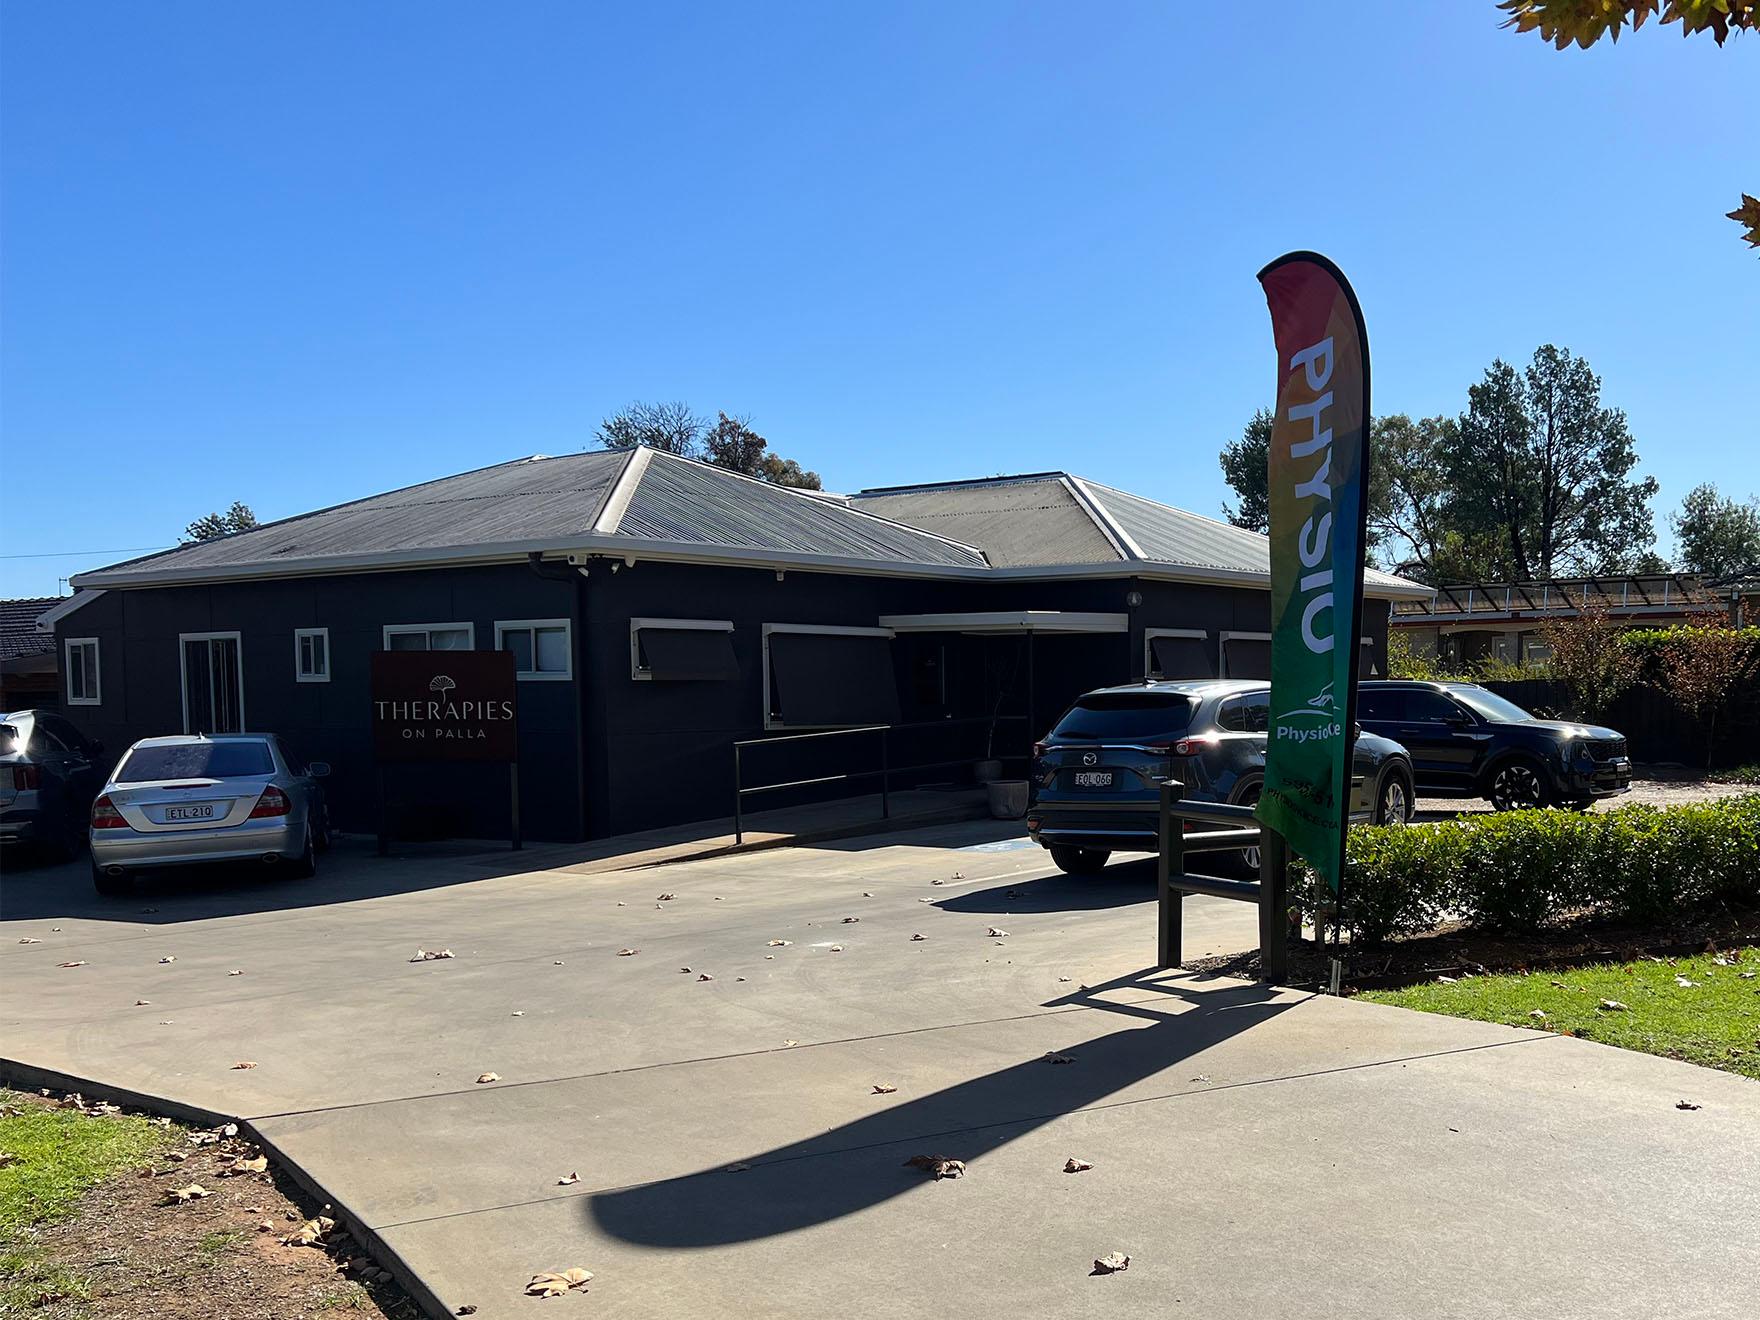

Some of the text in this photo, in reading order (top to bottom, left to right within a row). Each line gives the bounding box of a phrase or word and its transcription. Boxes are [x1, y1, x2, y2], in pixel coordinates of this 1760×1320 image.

[1288, 336, 1335, 655] PHYSIO
[375, 701, 513, 720] THERAPIES
[402, 728, 486, 739] ON PALLA
